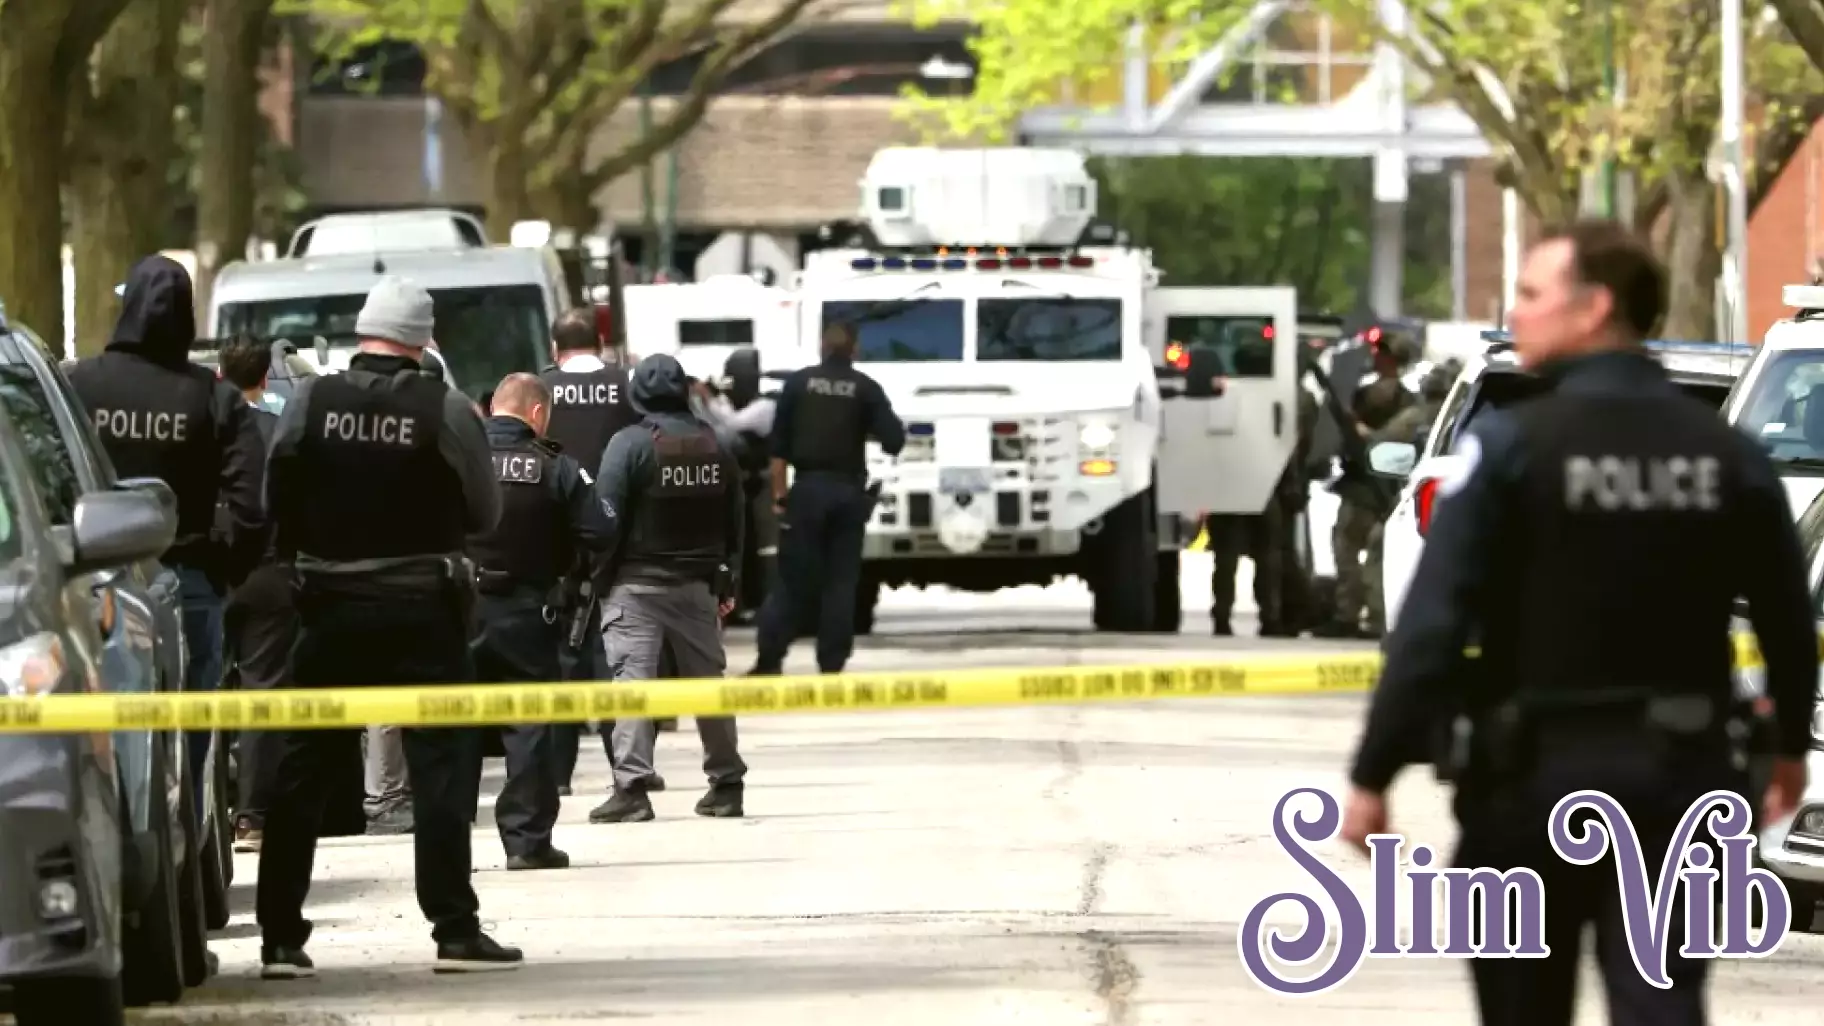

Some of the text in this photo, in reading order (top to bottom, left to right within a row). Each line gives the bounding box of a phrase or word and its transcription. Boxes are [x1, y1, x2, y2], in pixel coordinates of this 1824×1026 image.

[553, 384, 619, 405] POLICE
[806, 377, 857, 398] POLICE
[95, 409, 188, 441] POLICE
[324, 412, 414, 445] POLICE
[661, 463, 720, 486] POLICE
[1564, 455, 1720, 513] POLICE
